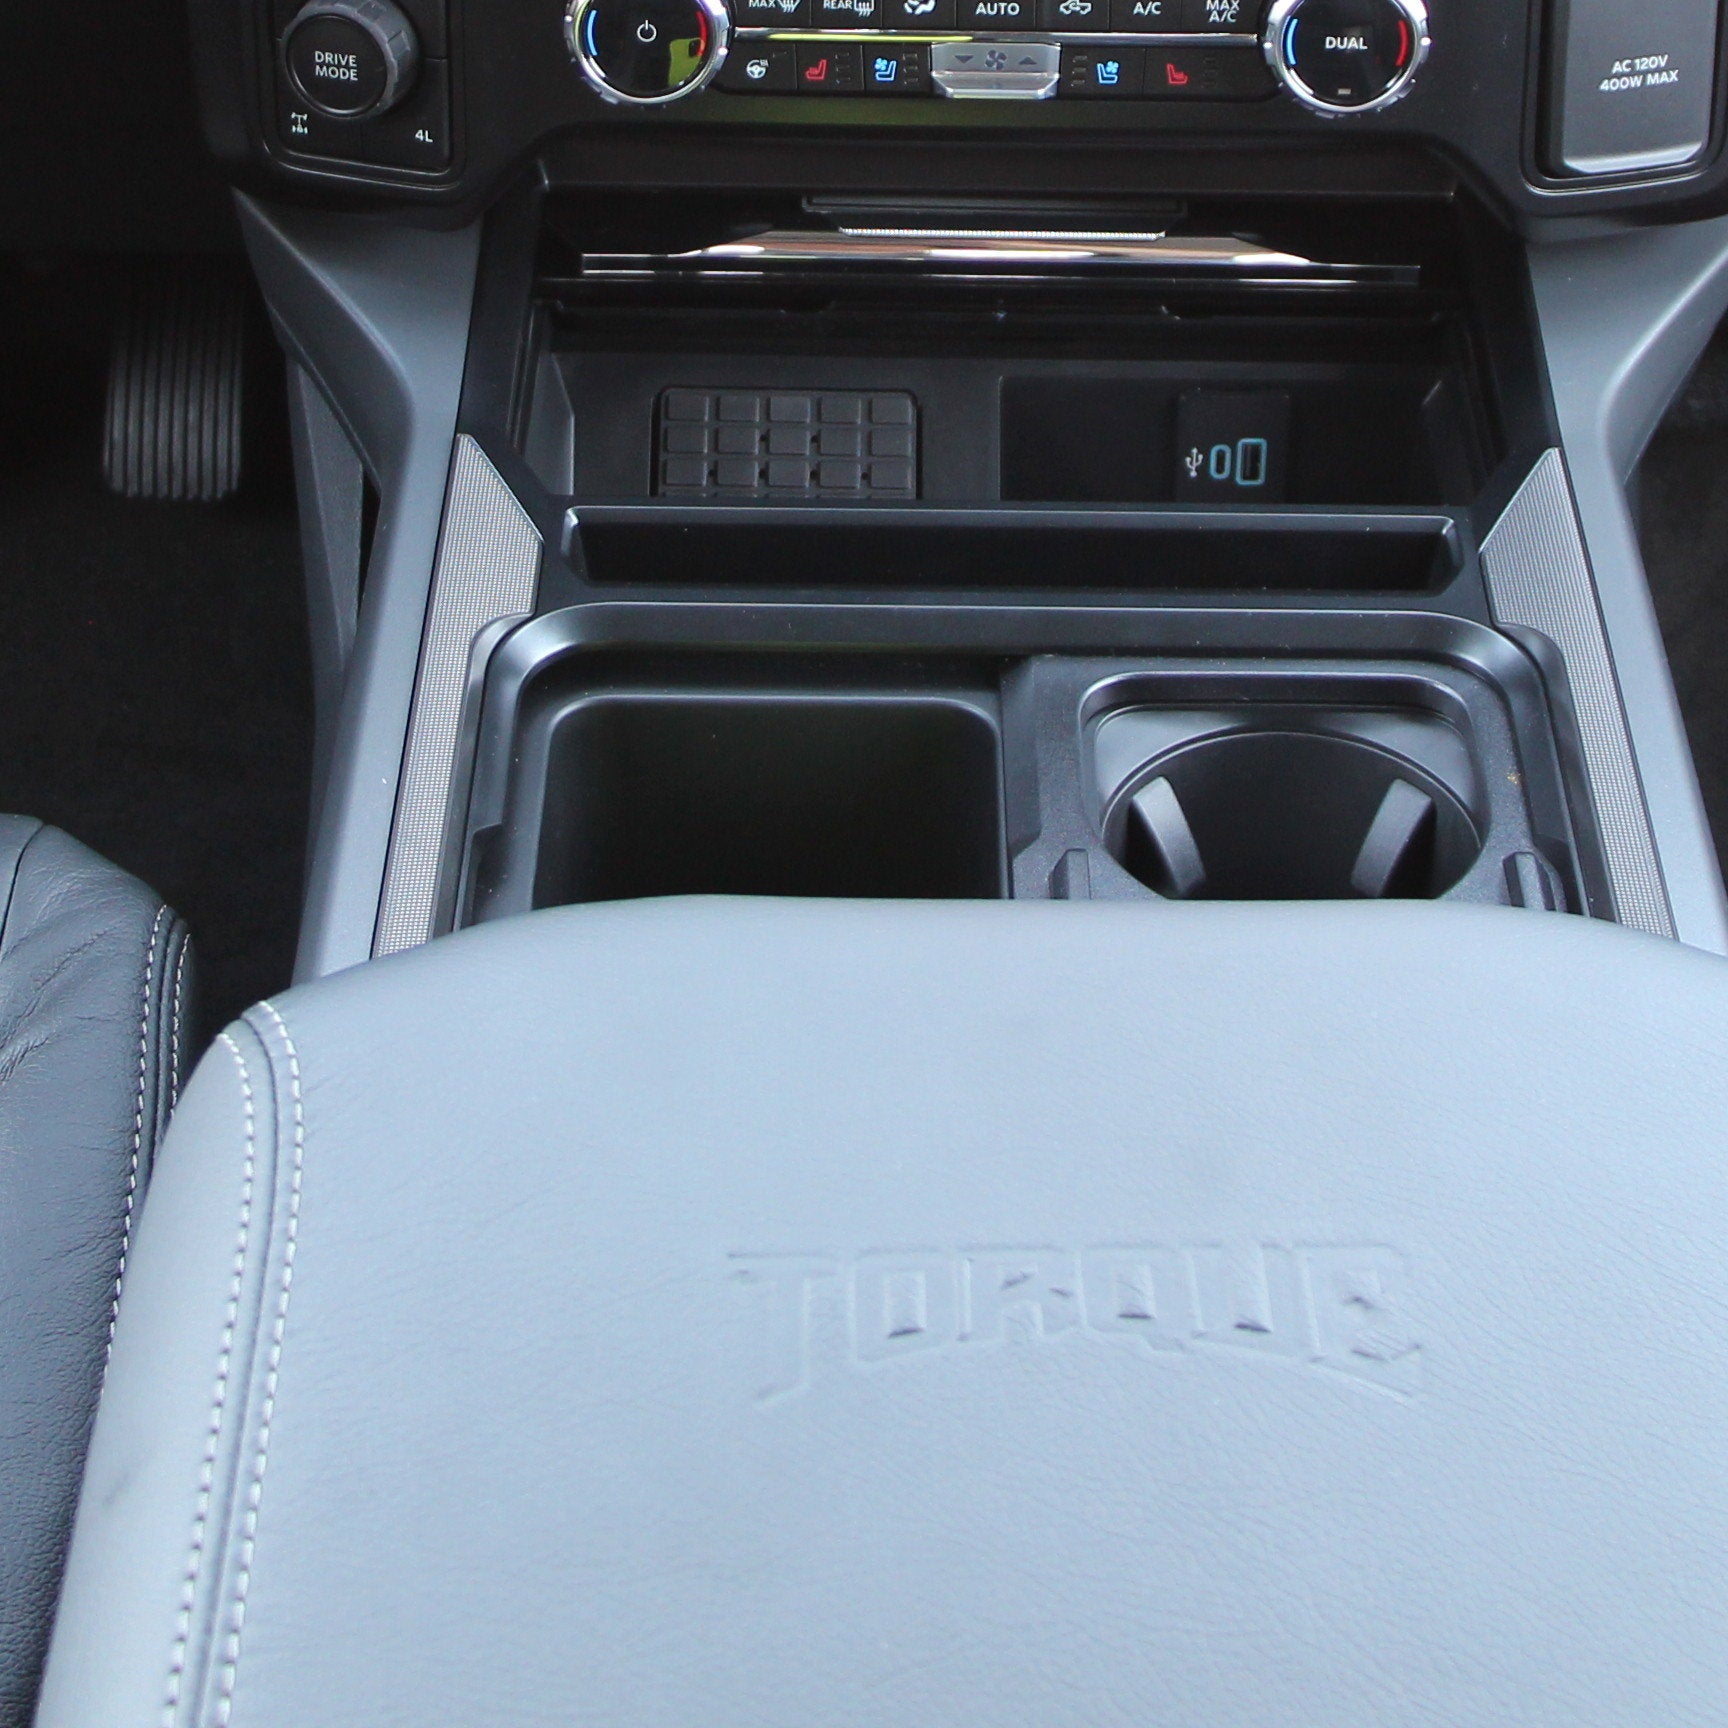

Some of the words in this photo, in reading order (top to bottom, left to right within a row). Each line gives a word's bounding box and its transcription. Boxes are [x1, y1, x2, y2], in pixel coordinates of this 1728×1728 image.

[975, 2, 1020, 16] AUTO
[1133, 1, 1161, 15] A/C
[1209, 10, 1237, 23] A/C
[1325, 36, 1368, 50] DUAL
[314, 50, 357, 67] DRIVE
[1612, 59, 1632, 74] AC
[1634, 54, 1668, 71] 120V
[315, 65, 358, 81] MODE
[1599, 75, 1643, 92] 400W
[1646, 69, 1679, 85] MAX
[414, 129, 434, 144] 4L
[726, 1240, 1424, 1410] TORQUE
